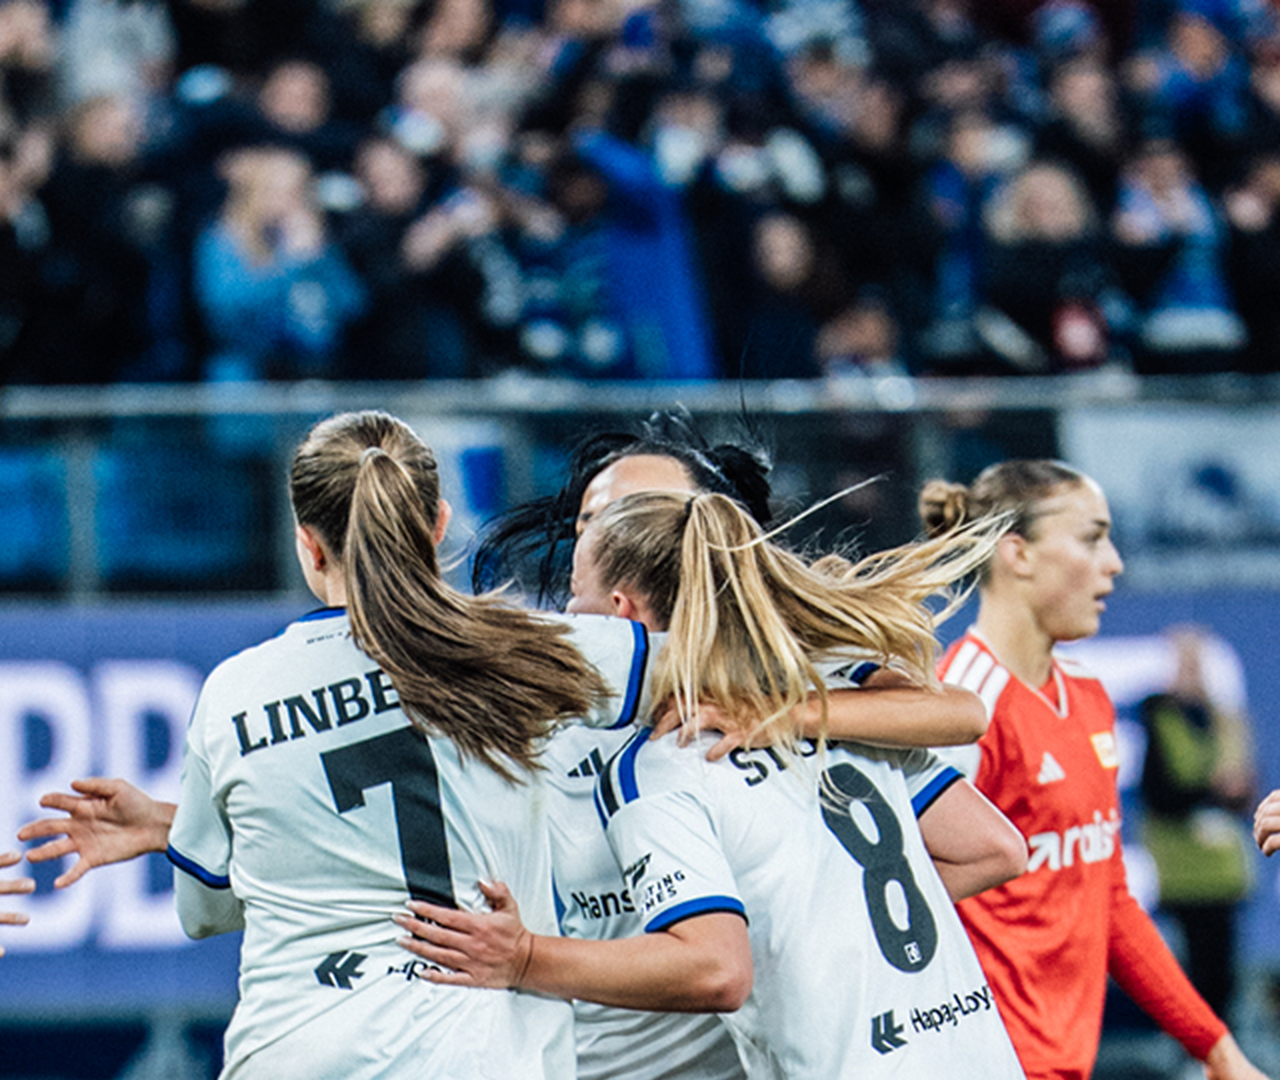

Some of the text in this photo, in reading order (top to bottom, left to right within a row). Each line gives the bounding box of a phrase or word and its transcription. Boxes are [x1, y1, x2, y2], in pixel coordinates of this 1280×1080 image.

[231, 667, 402, 757] LINBE
[320, 725, 460, 941] 7
[645, 869, 686, 900] TING
[819, 762, 938, 974] 8
[571, 889, 636, 919] Hans
[641, 885, 677, 915] MES
